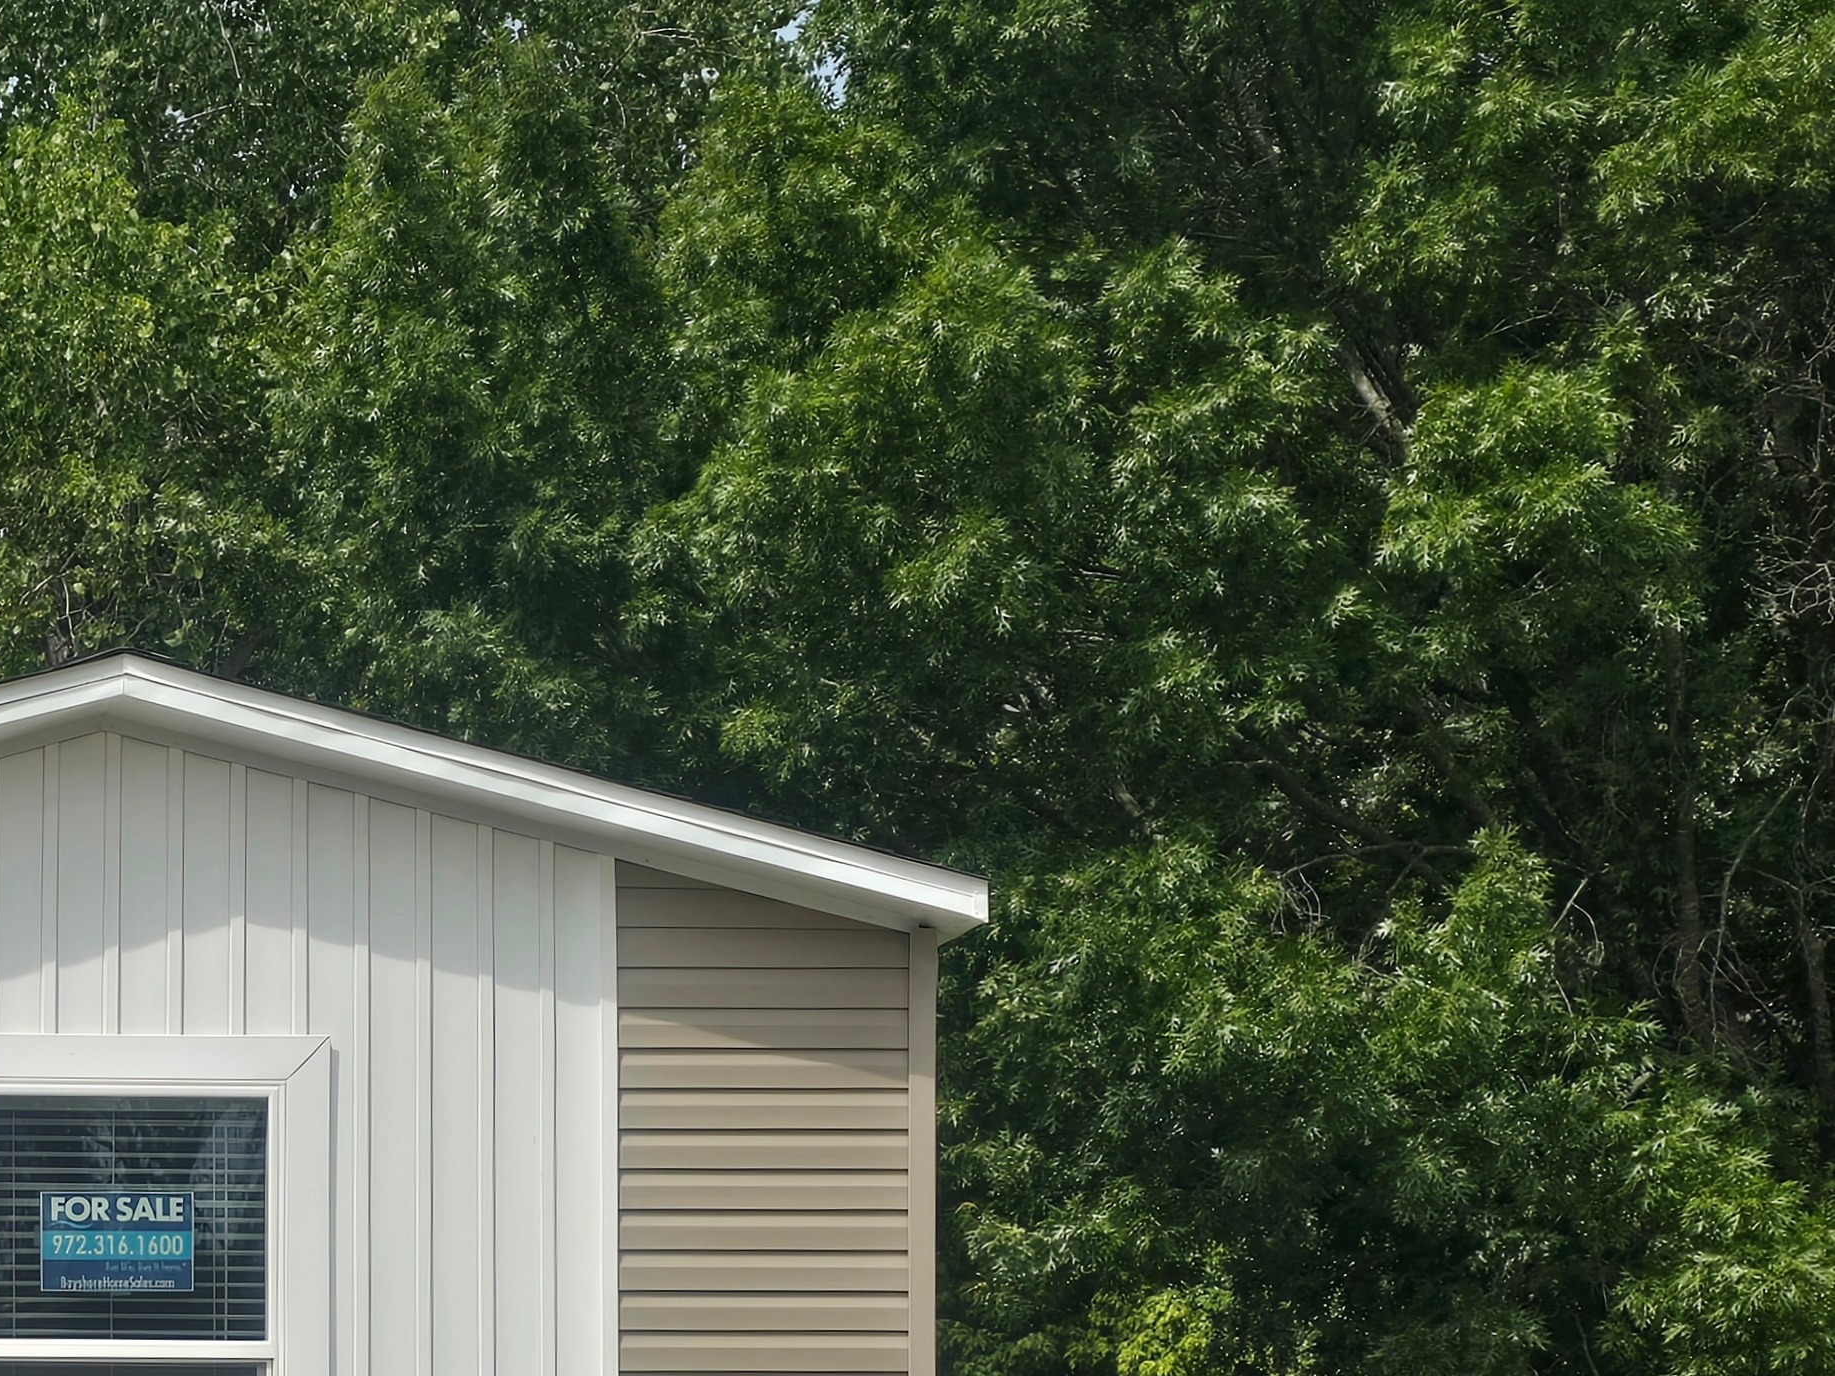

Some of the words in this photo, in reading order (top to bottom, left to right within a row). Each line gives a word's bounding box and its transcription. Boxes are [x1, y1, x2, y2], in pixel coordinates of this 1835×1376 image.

[51, 1197, 110, 1222] FOR
[116, 1197, 184, 1222] SALE
[53, 1235, 183, 1255] 972.316.1600
